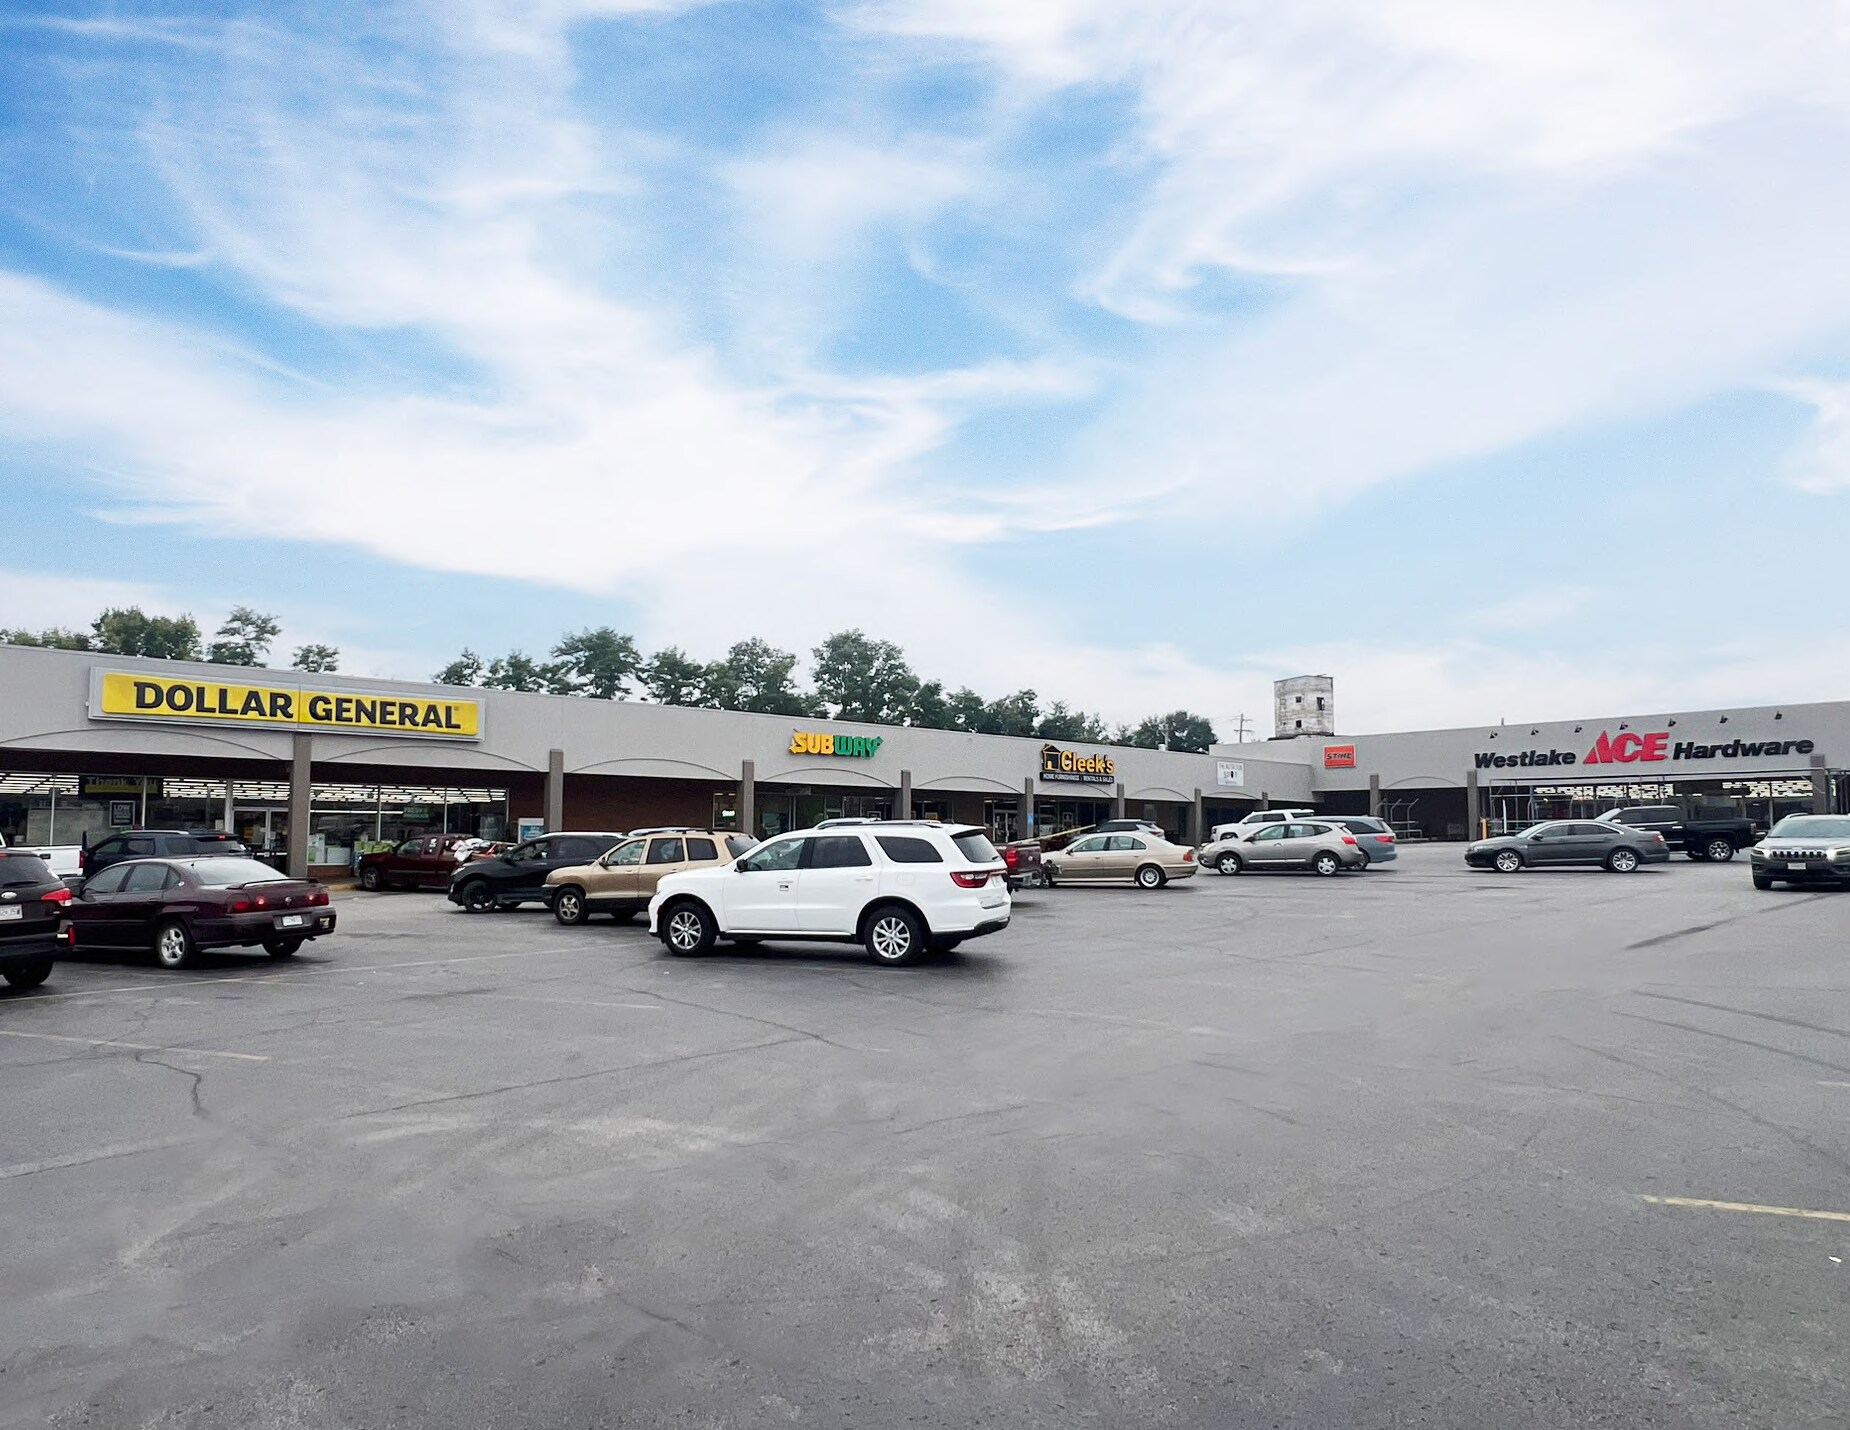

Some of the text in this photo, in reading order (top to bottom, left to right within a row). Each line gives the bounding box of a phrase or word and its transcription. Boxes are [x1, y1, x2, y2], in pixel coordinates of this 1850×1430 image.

[134, 681, 461, 729] DOLLAR GENERAL
[789, 732, 884, 757] SUBWAY
[1474, 730, 1814, 768] Westlake ACE Hardware
